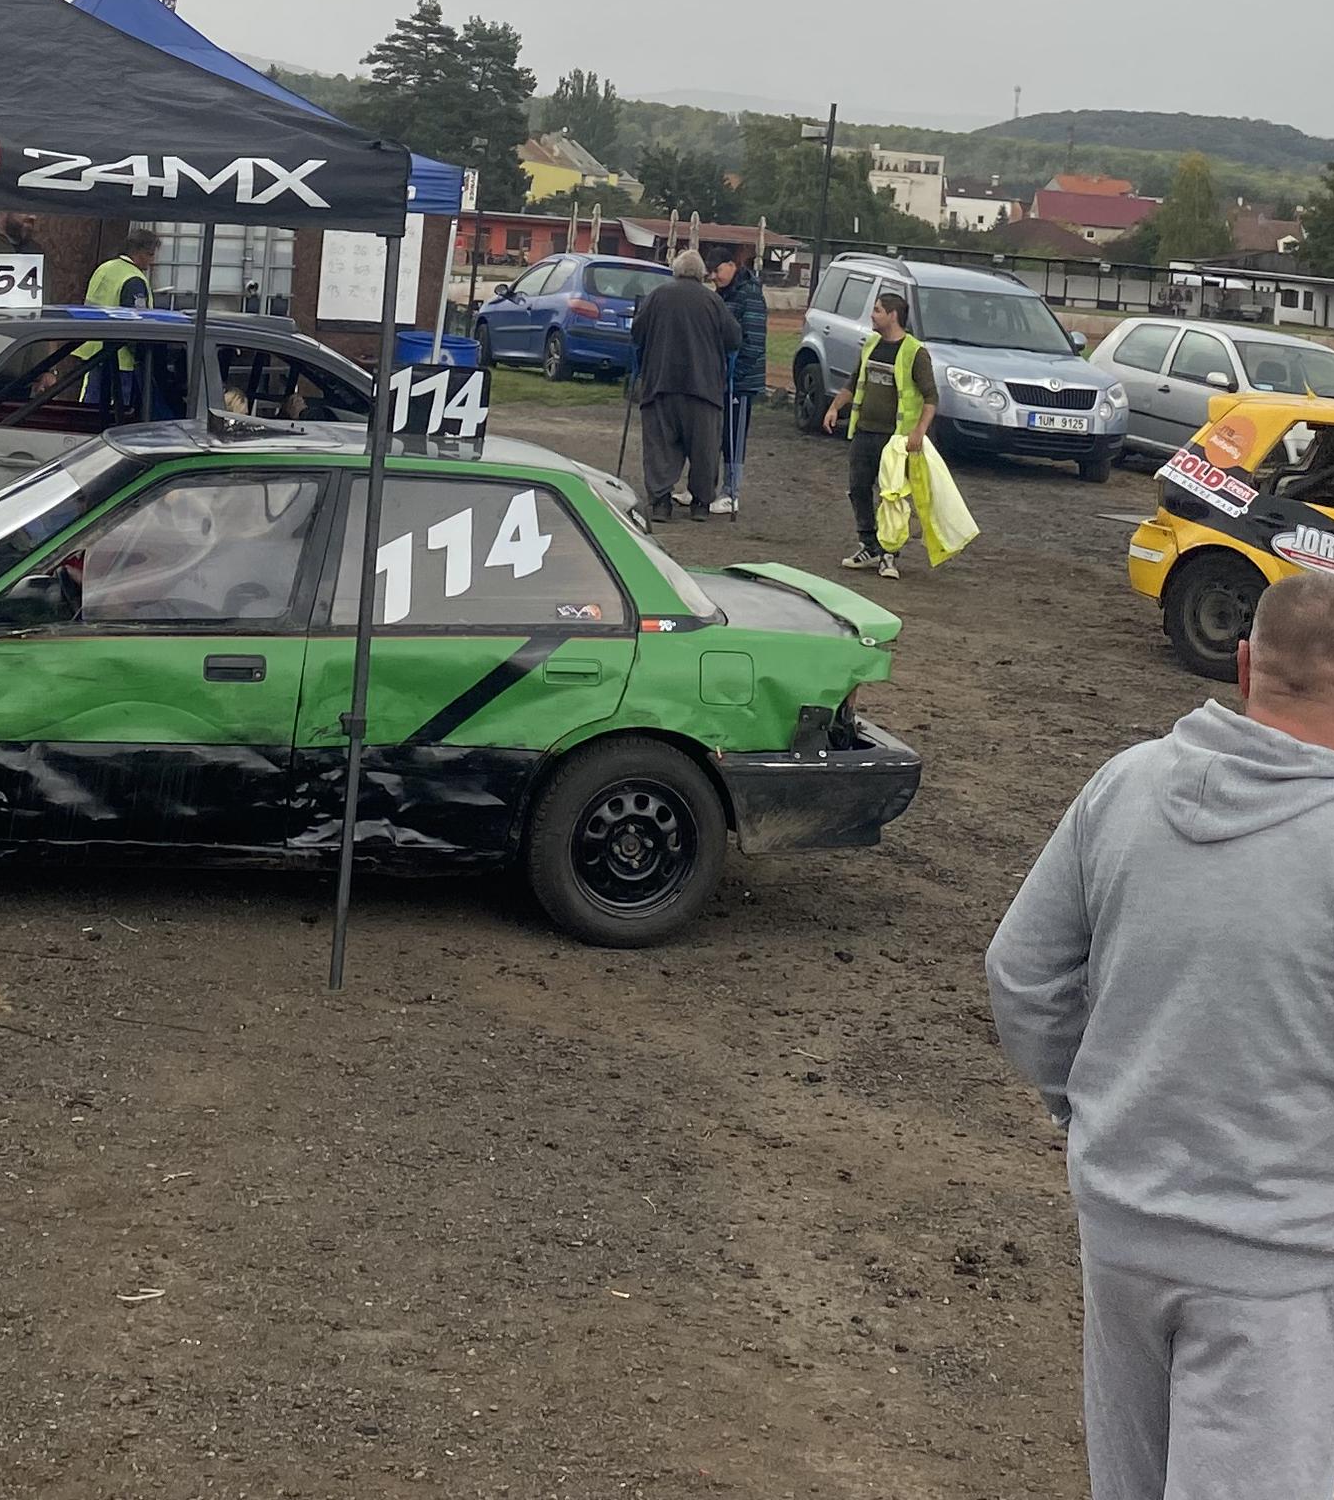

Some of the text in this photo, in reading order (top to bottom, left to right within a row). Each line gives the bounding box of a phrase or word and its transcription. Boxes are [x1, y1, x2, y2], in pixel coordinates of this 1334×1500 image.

[18, 148, 331, 208] 24MX
[389, 366, 489, 437] 114
[1061, 417, 1084, 429] 9125
[1170, 451, 1226, 489] GOLD
[376, 489, 552, 625] 114
